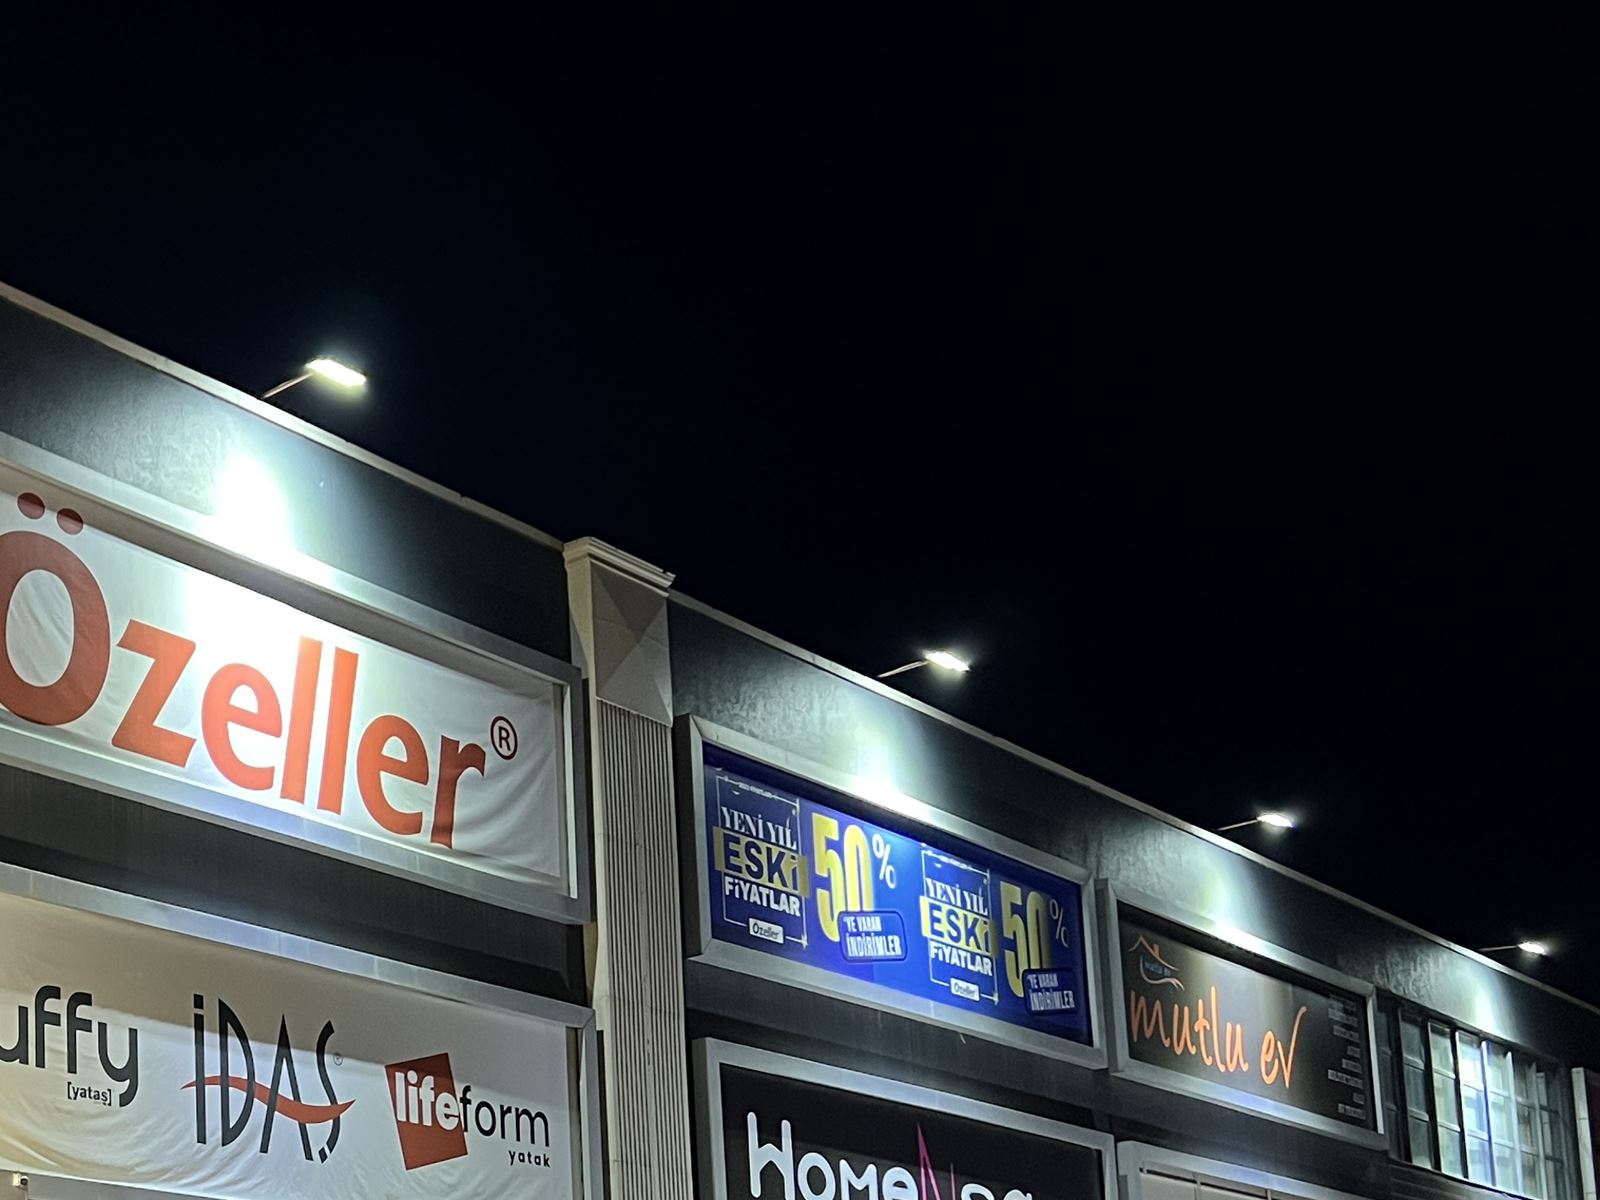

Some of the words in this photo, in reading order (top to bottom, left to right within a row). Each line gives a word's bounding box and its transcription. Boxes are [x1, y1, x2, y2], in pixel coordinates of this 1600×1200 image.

[722, 831, 801, 892] ESKİ
[724, 876, 801, 917] FİYATLAR
[931, 942, 993, 977] FİYATLAR
[1130, 985, 1250, 1073] mutlu
[1260, 1005, 1308, 1089] ev
[508, 1150, 551, 1168] yatak
